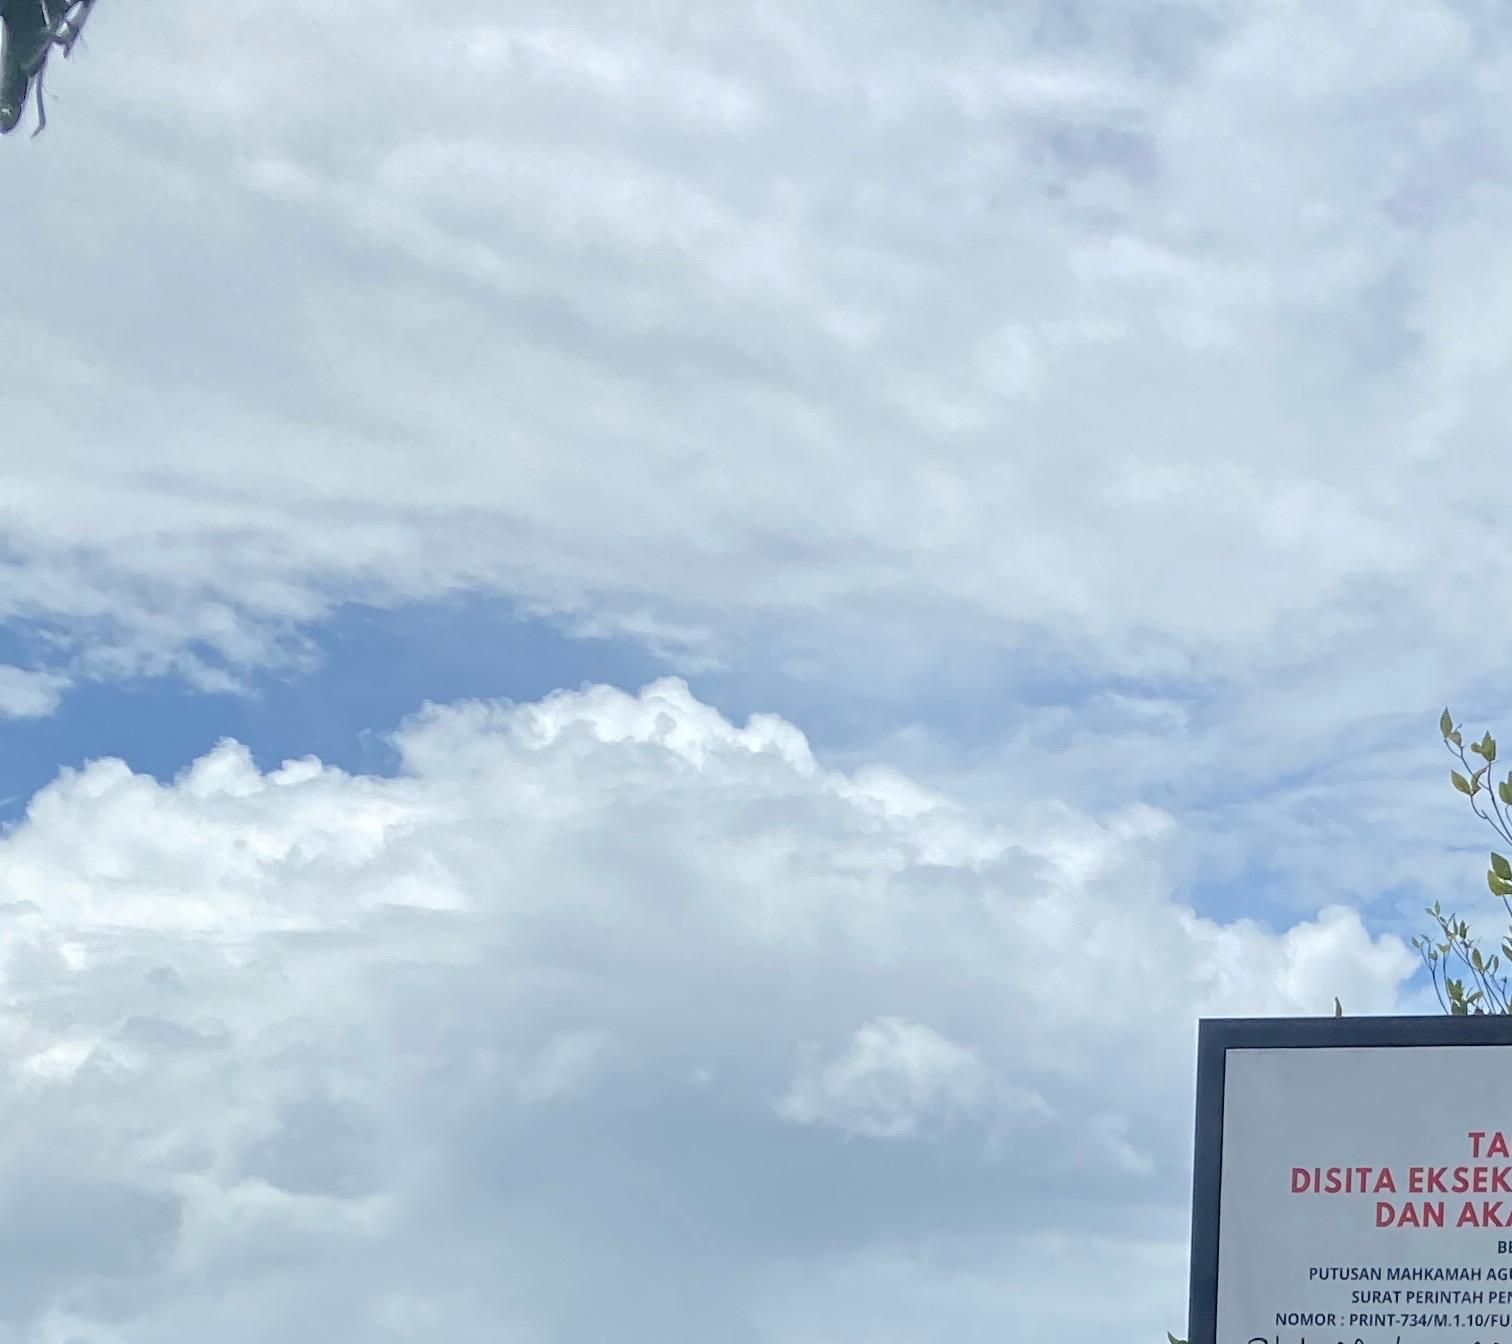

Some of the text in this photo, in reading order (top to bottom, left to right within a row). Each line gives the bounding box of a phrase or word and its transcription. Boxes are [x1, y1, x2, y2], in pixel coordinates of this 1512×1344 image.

[1291, 1167, 1396, 1194] DISITA
[1376, 1201, 1444, 1228] DAN
[1309, 1267, 1382, 1281] PUTUSAN
[1387, 1267, 1482, 1281] MAHKAMAH
[1351, 1290, 1402, 1305] SURAT
[1406, 1290, 1483, 1304] PERINTAH
[1275, 1312, 1336, 1327] NOMOR
